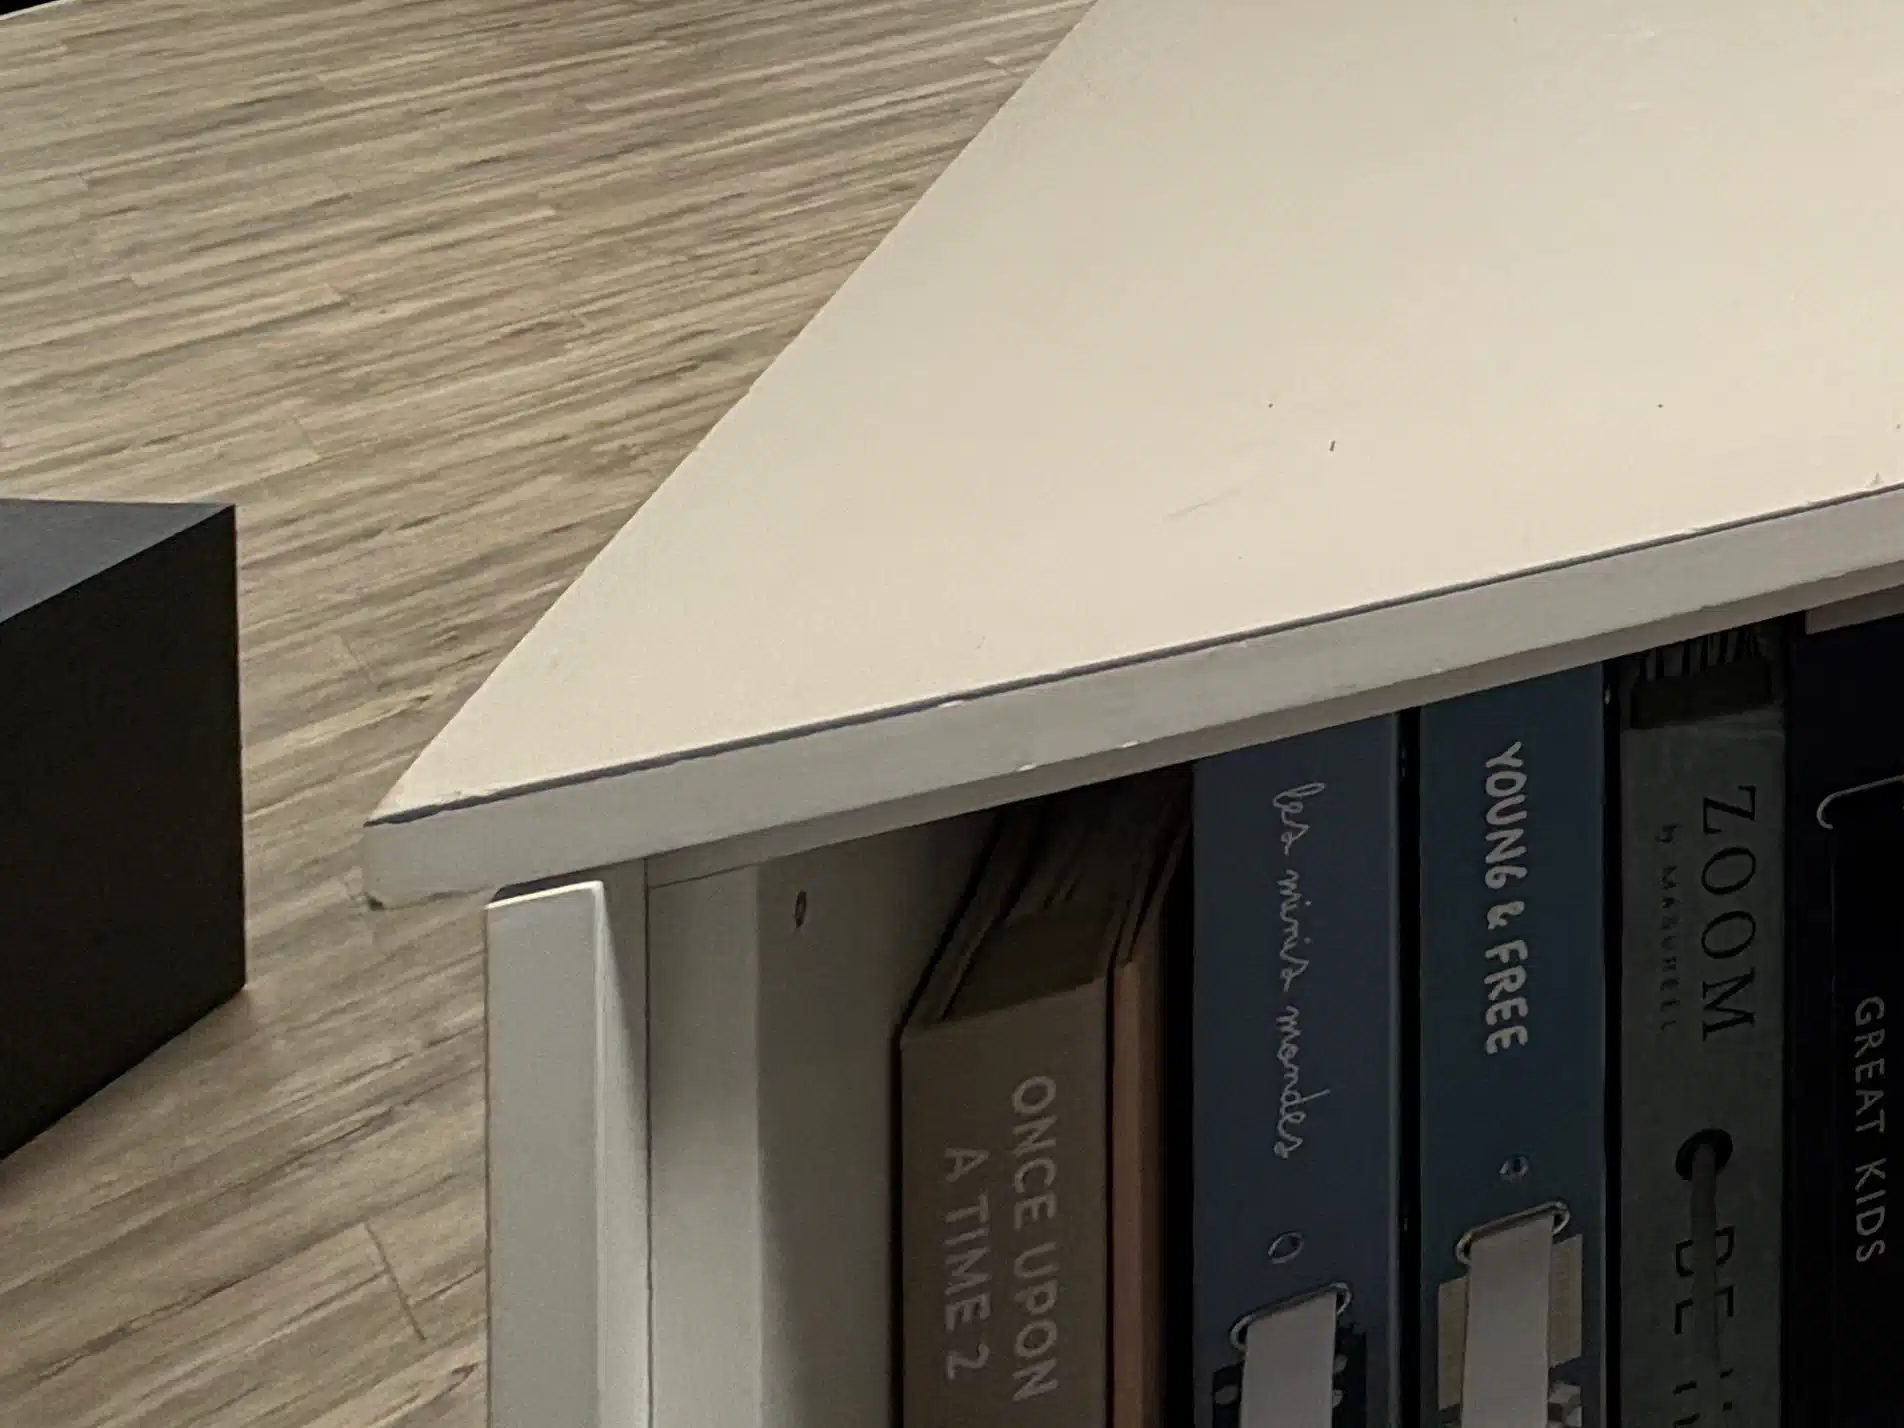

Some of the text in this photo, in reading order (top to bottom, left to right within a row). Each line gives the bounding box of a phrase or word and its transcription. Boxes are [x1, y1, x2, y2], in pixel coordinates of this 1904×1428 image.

[1484, 741, 1528, 890] YOUNG
[1701, 785, 1757, 1042] ZOOM
[1484, 939, 1529, 1056] FREE
[1012, 1075, 1059, 1402] ONCE UPON
[1854, 995, 1888, 1264] GREAT KIDS
[944, 1147, 991, 1381] A TIME 2
